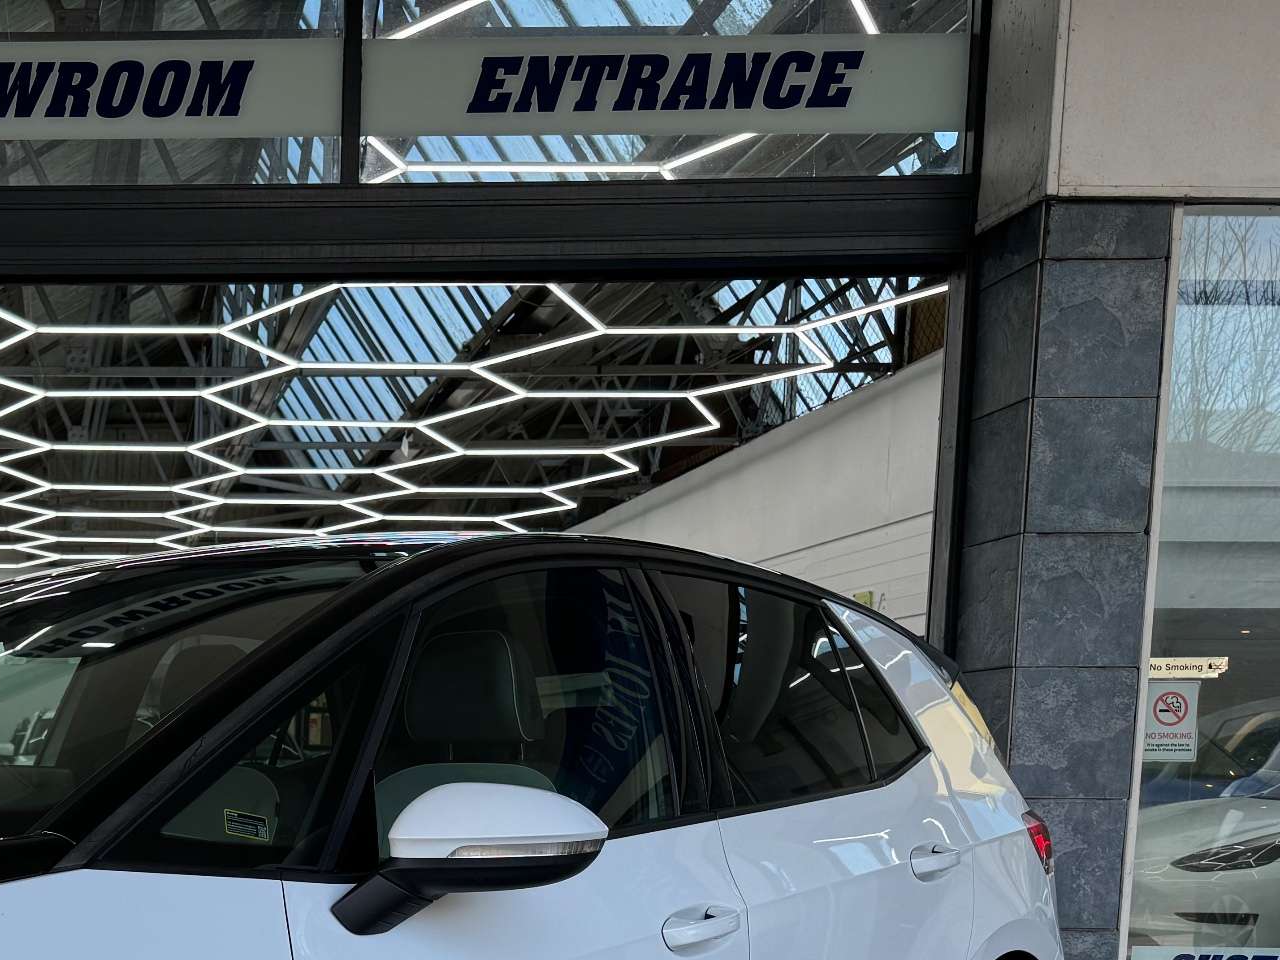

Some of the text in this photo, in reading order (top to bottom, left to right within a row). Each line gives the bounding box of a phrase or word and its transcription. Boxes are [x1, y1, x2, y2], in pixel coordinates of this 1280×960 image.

[465, 50, 865, 114] ENTRANCE
[1149, 663, 1204, 673] No Smoking
[1145, 732, 1157, 740] NO
